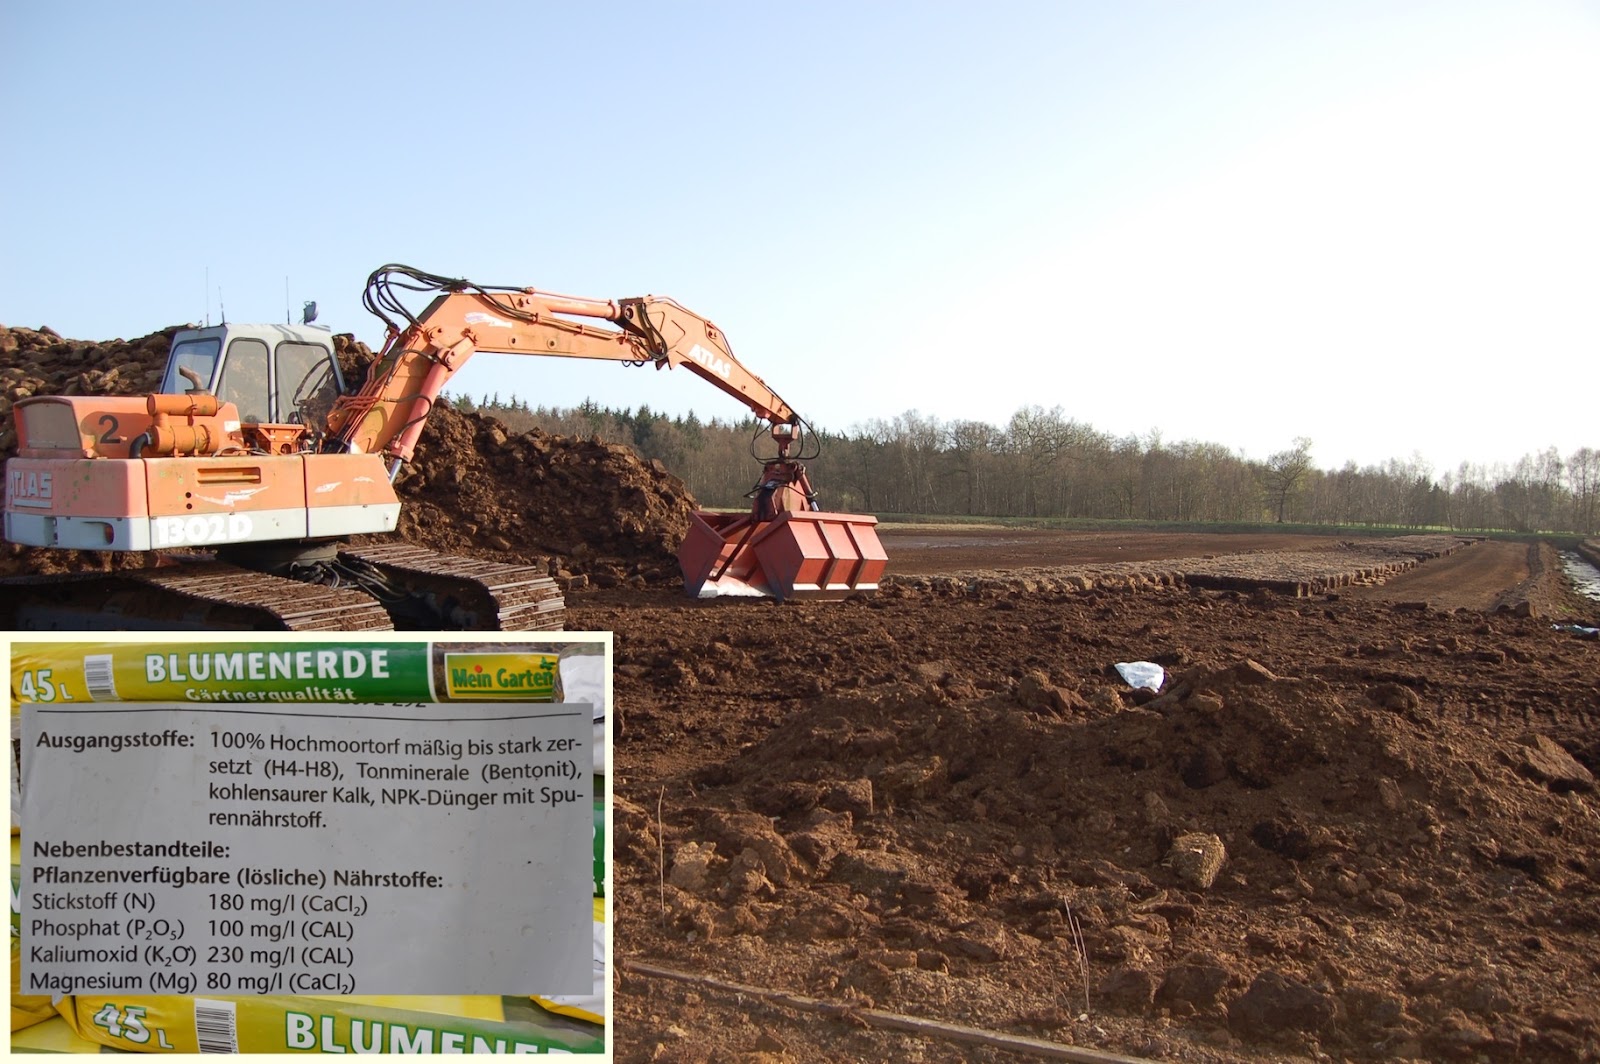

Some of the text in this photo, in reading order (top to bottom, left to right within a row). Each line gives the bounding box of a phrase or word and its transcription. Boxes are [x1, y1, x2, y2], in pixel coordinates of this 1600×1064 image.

[689, 343, 731, 378] ATLAS
[98, 415, 120, 444] 2
[9, 471, 52, 499] ATLAS
[145, 650, 390, 682] BLUMENERDE
[452, 665, 554, 689] Mein Garten
[21, 669, 73, 702] 45 L
[185, 686, 357, 702] Gärtnerqualität
[36, 730, 582, 760] Ausgangsstoffe: 100% Hochmoortorf mäßig bis stark zer-
[209, 759, 582, 784] setzt (H4-H8), Tonminerale (Bentonit),
[210, 782, 583, 810] kohlensaurer Kalk, NPK-Dünger mit Spu-
[209, 810, 326, 828] rennährstoff.
[34, 840, 229, 858] Nebenbestandteile:
[33, 866, 443, 890] Pflanzenverfügbare (lösliche) Nährstoffe:
[32, 892, 117, 910] Stickstoff
[123, 892, 155, 913] (N)
[209, 894, 244, 911] 180
[251, 894, 294, 916] mg/l
[32, 918, 120, 941] Phosphat
[209, 920, 244, 937] 100
[251, 920, 294, 942] mg/l
[302, 921, 353, 942] (CAL)
[31, 945, 137, 963] Kaliumoxid
[207, 946, 244, 963] 230
[251, 946, 294, 969] mg/l
[301, 947, 353, 968] (CAL)
[30, 972, 142, 994] Magnesium
[149, 972, 197, 994] (Mg)
[207, 972, 231, 989] 80
[238, 972, 282, 995] mg/l
[93, 1003, 174, 1049] 45 L
